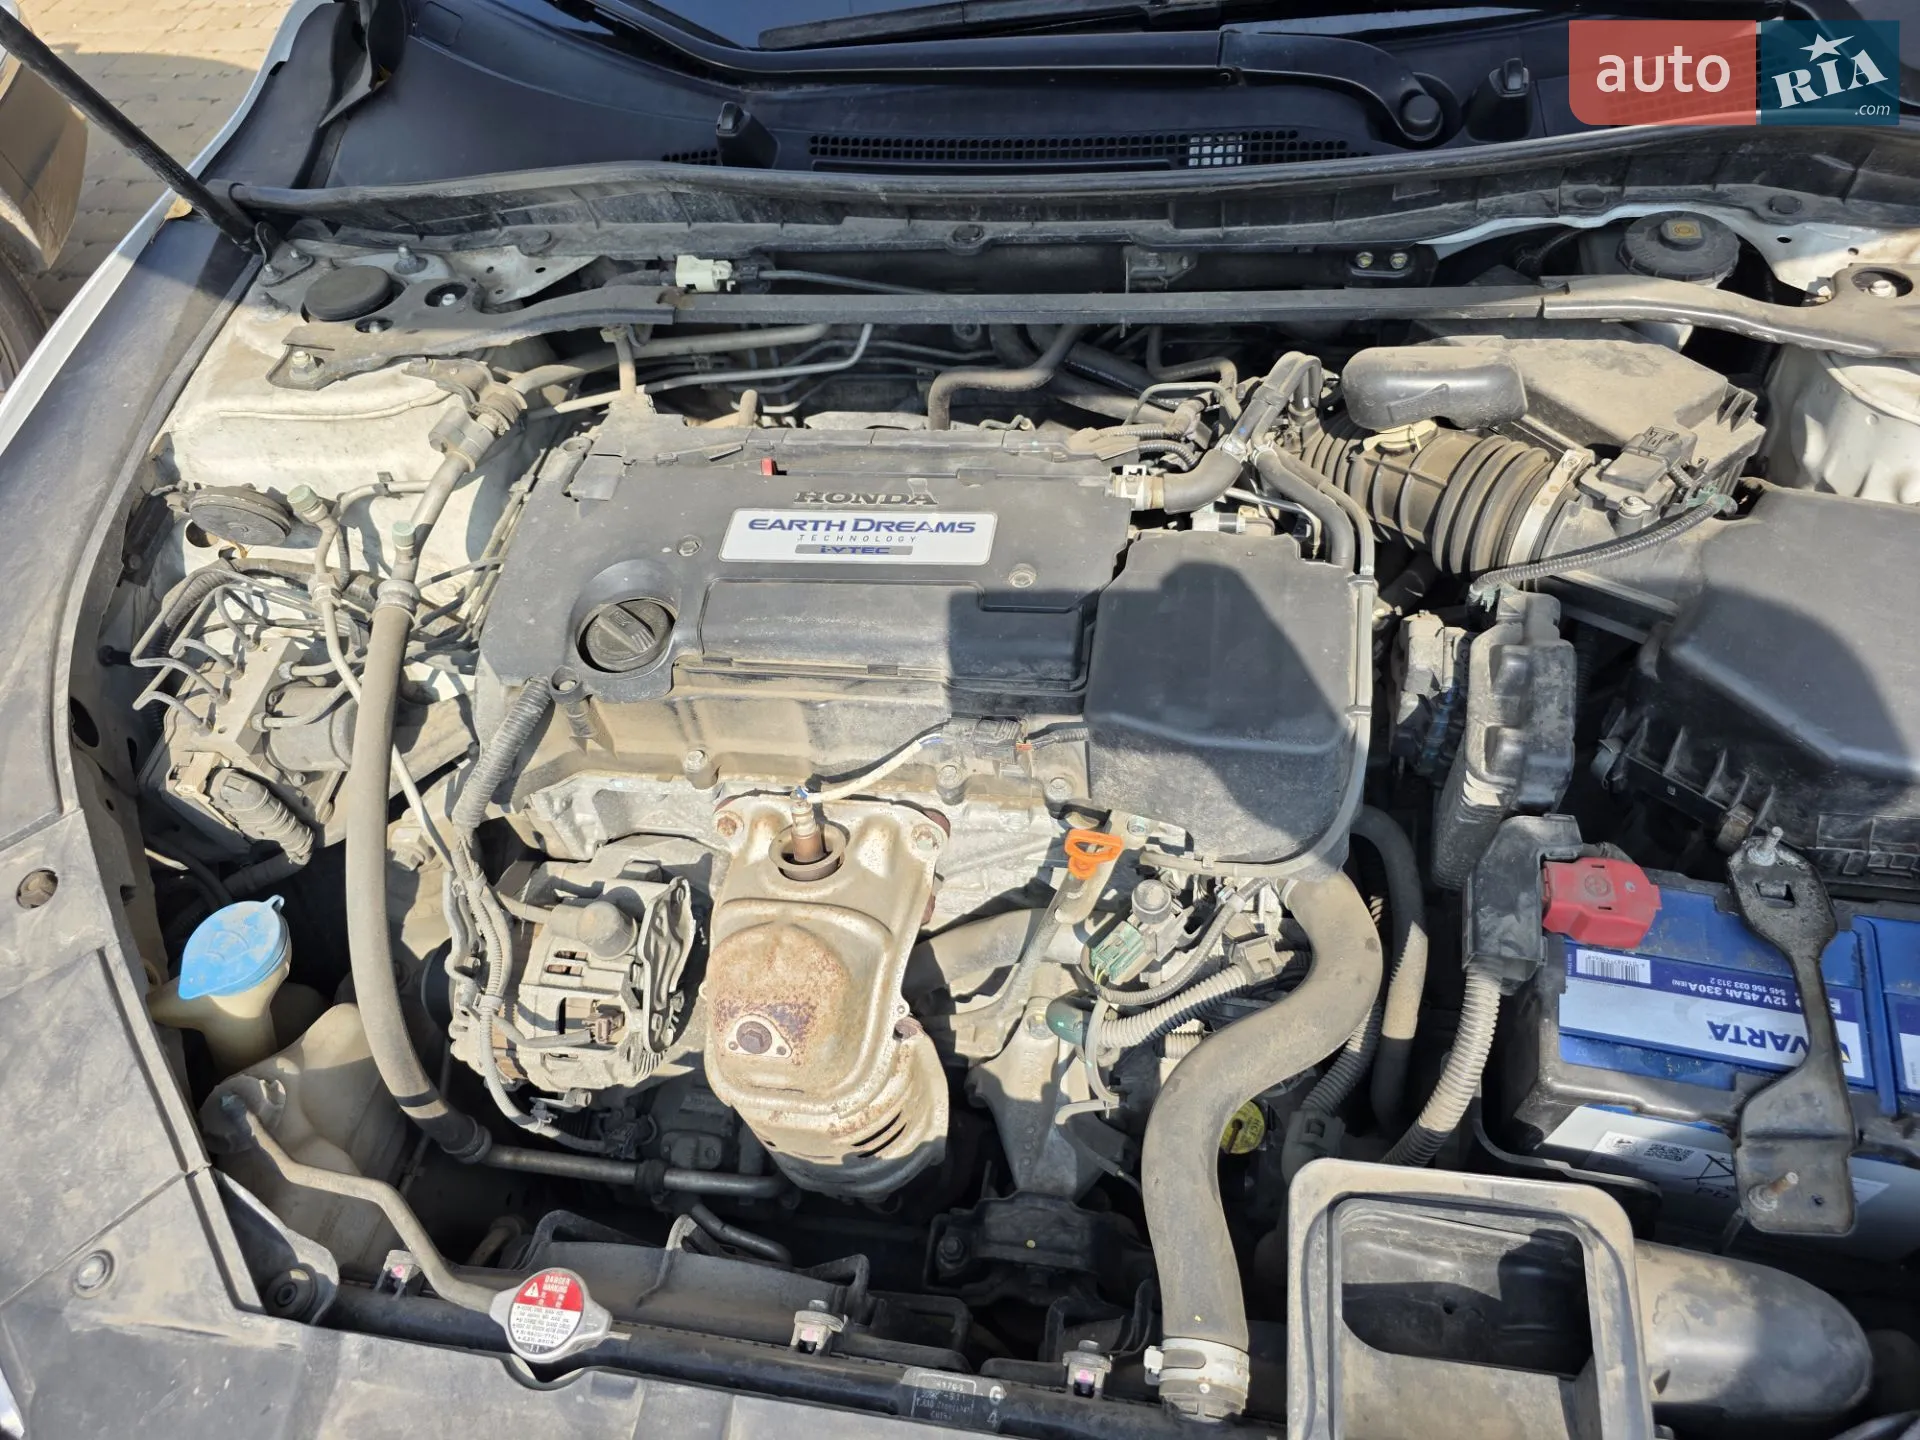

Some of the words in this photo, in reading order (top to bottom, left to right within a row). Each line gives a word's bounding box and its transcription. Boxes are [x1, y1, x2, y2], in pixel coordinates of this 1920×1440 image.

[793, 491, 938, 506] HONDA
[748, 518, 847, 532] EARTH
[852, 518, 976, 533] DREAMS
[798, 535, 918, 543] TECHNOLOGY
[1763, 995, 1788, 1006] 12V
[1706, 1020, 1810, 1054] VARTA
